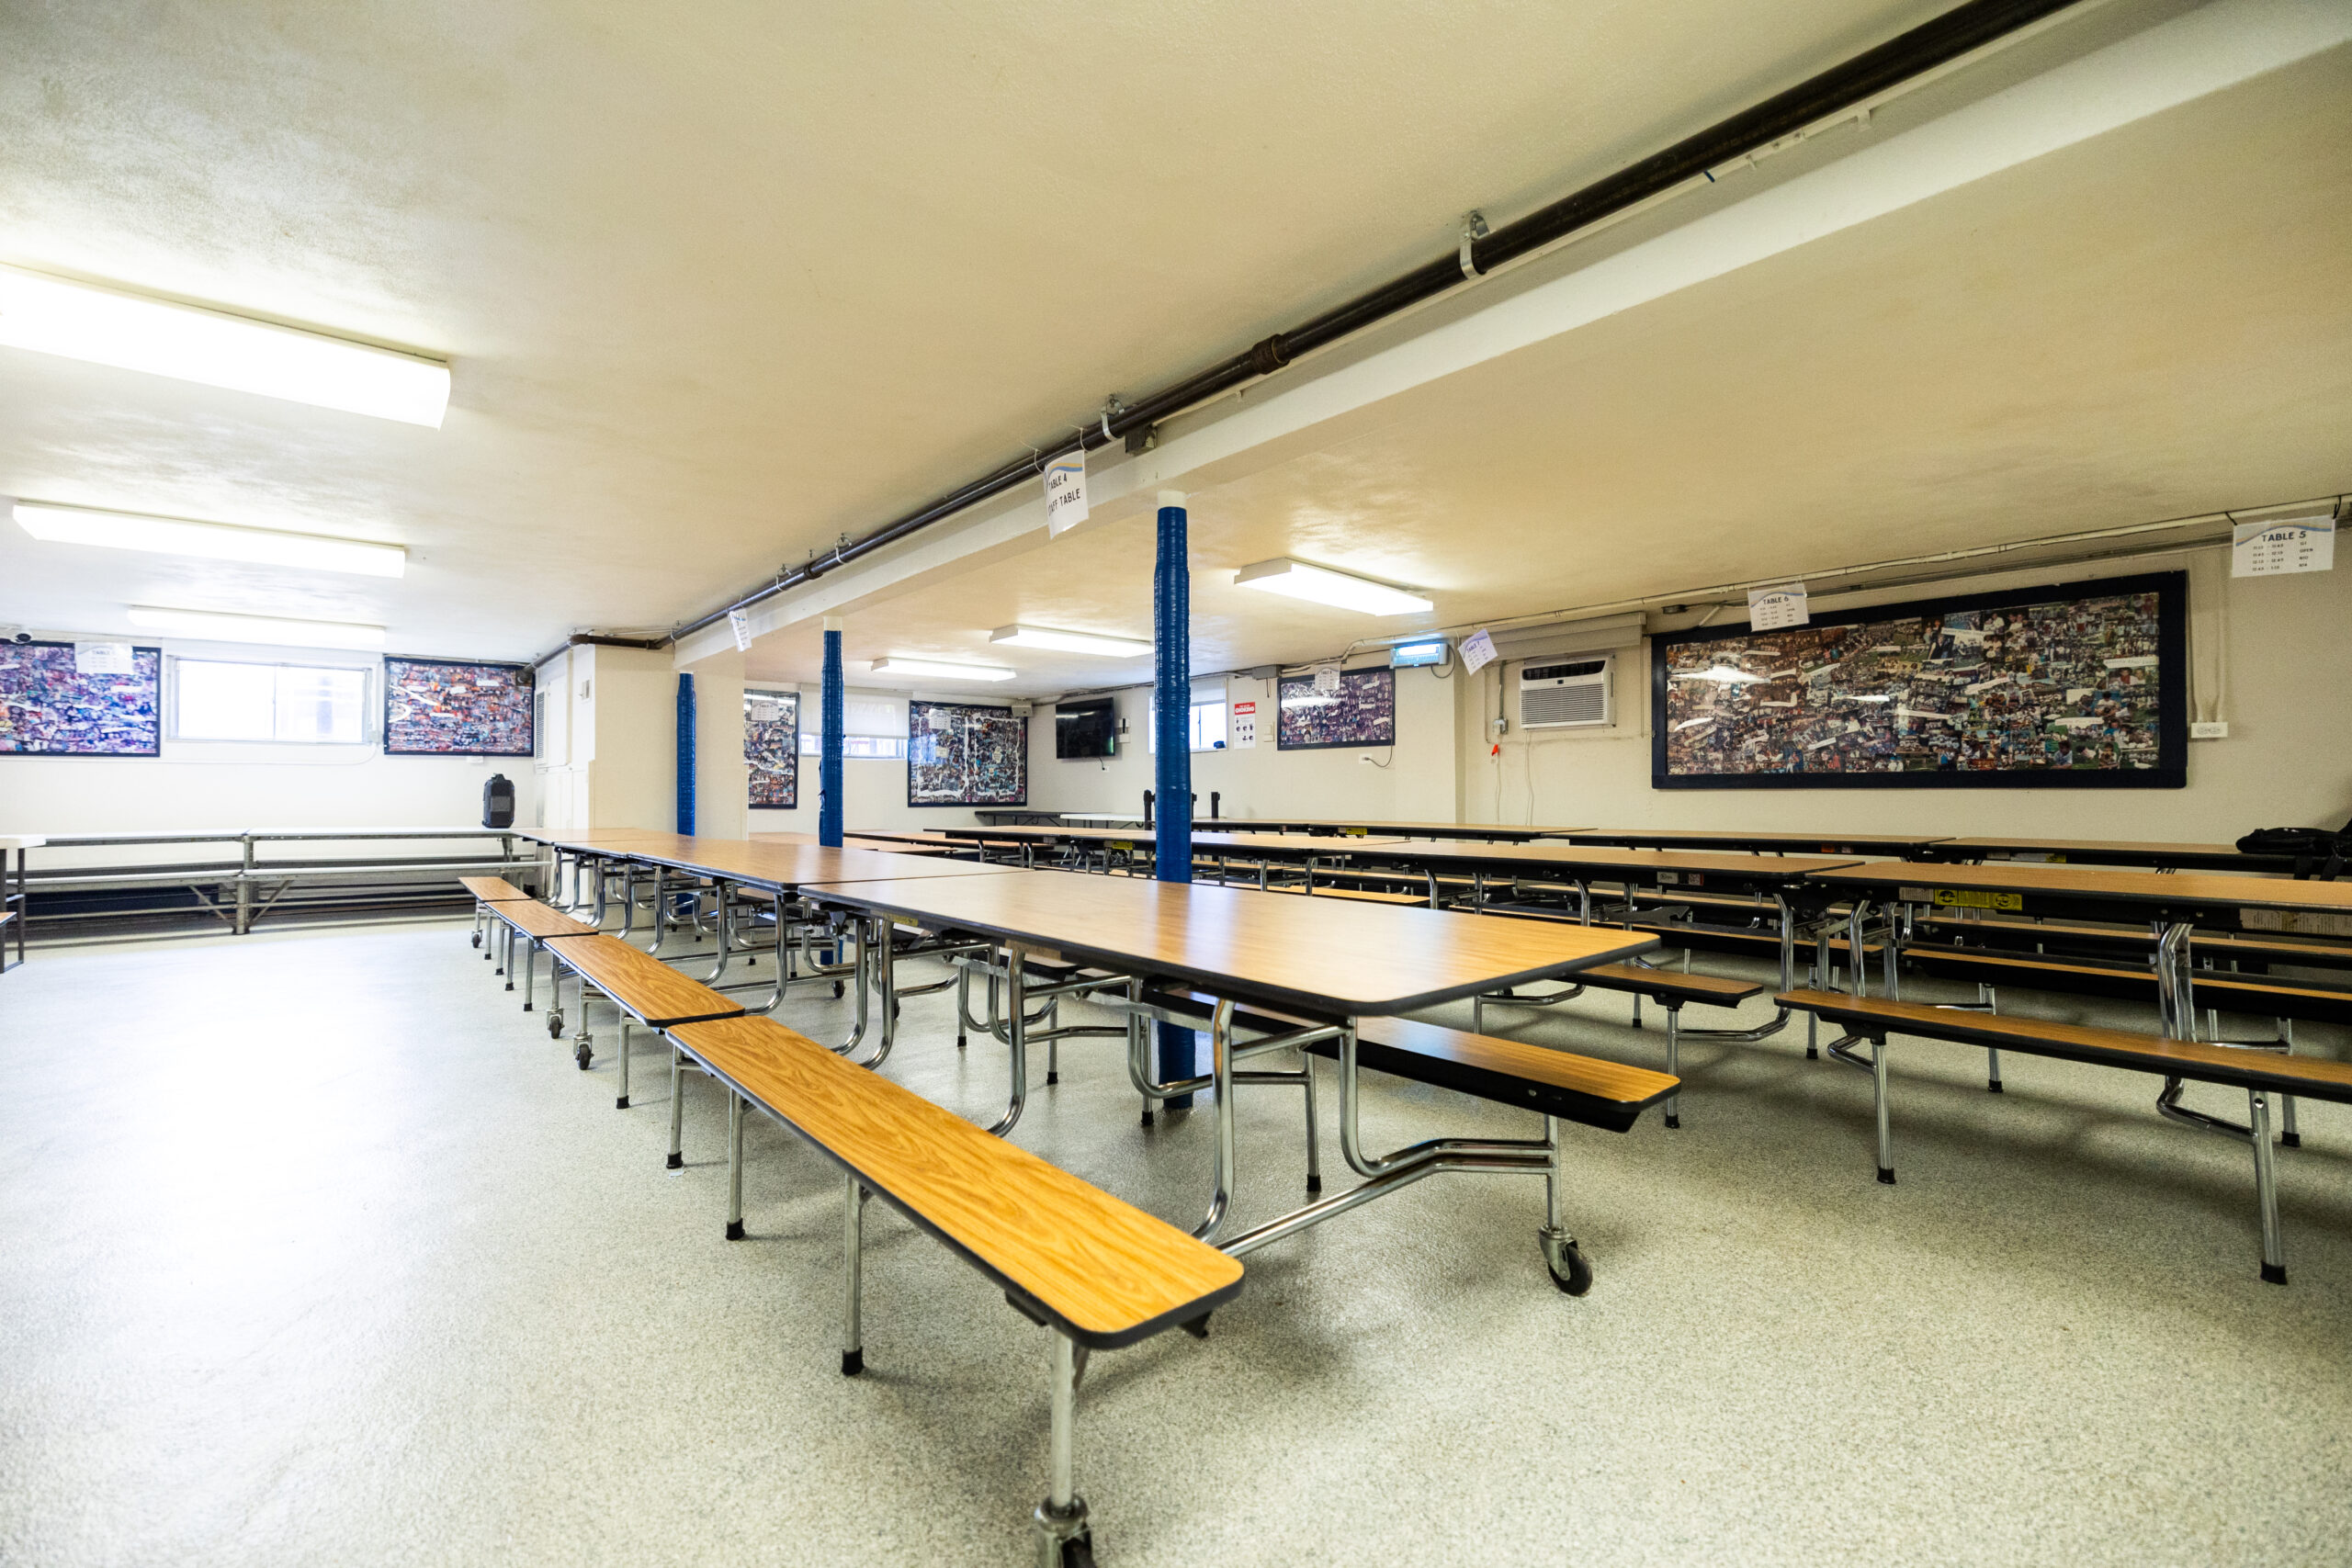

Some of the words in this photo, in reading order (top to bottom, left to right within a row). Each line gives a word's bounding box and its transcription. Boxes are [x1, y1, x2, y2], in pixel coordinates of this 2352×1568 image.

[1063, 472, 1068, 482] 4
[1059, 488, 1081, 507] TABLE
[2262, 532, 2295, 542] TABLE
[2299, 531, 2307, 539] 5
[1763, 597, 1782, 605] TABLE
